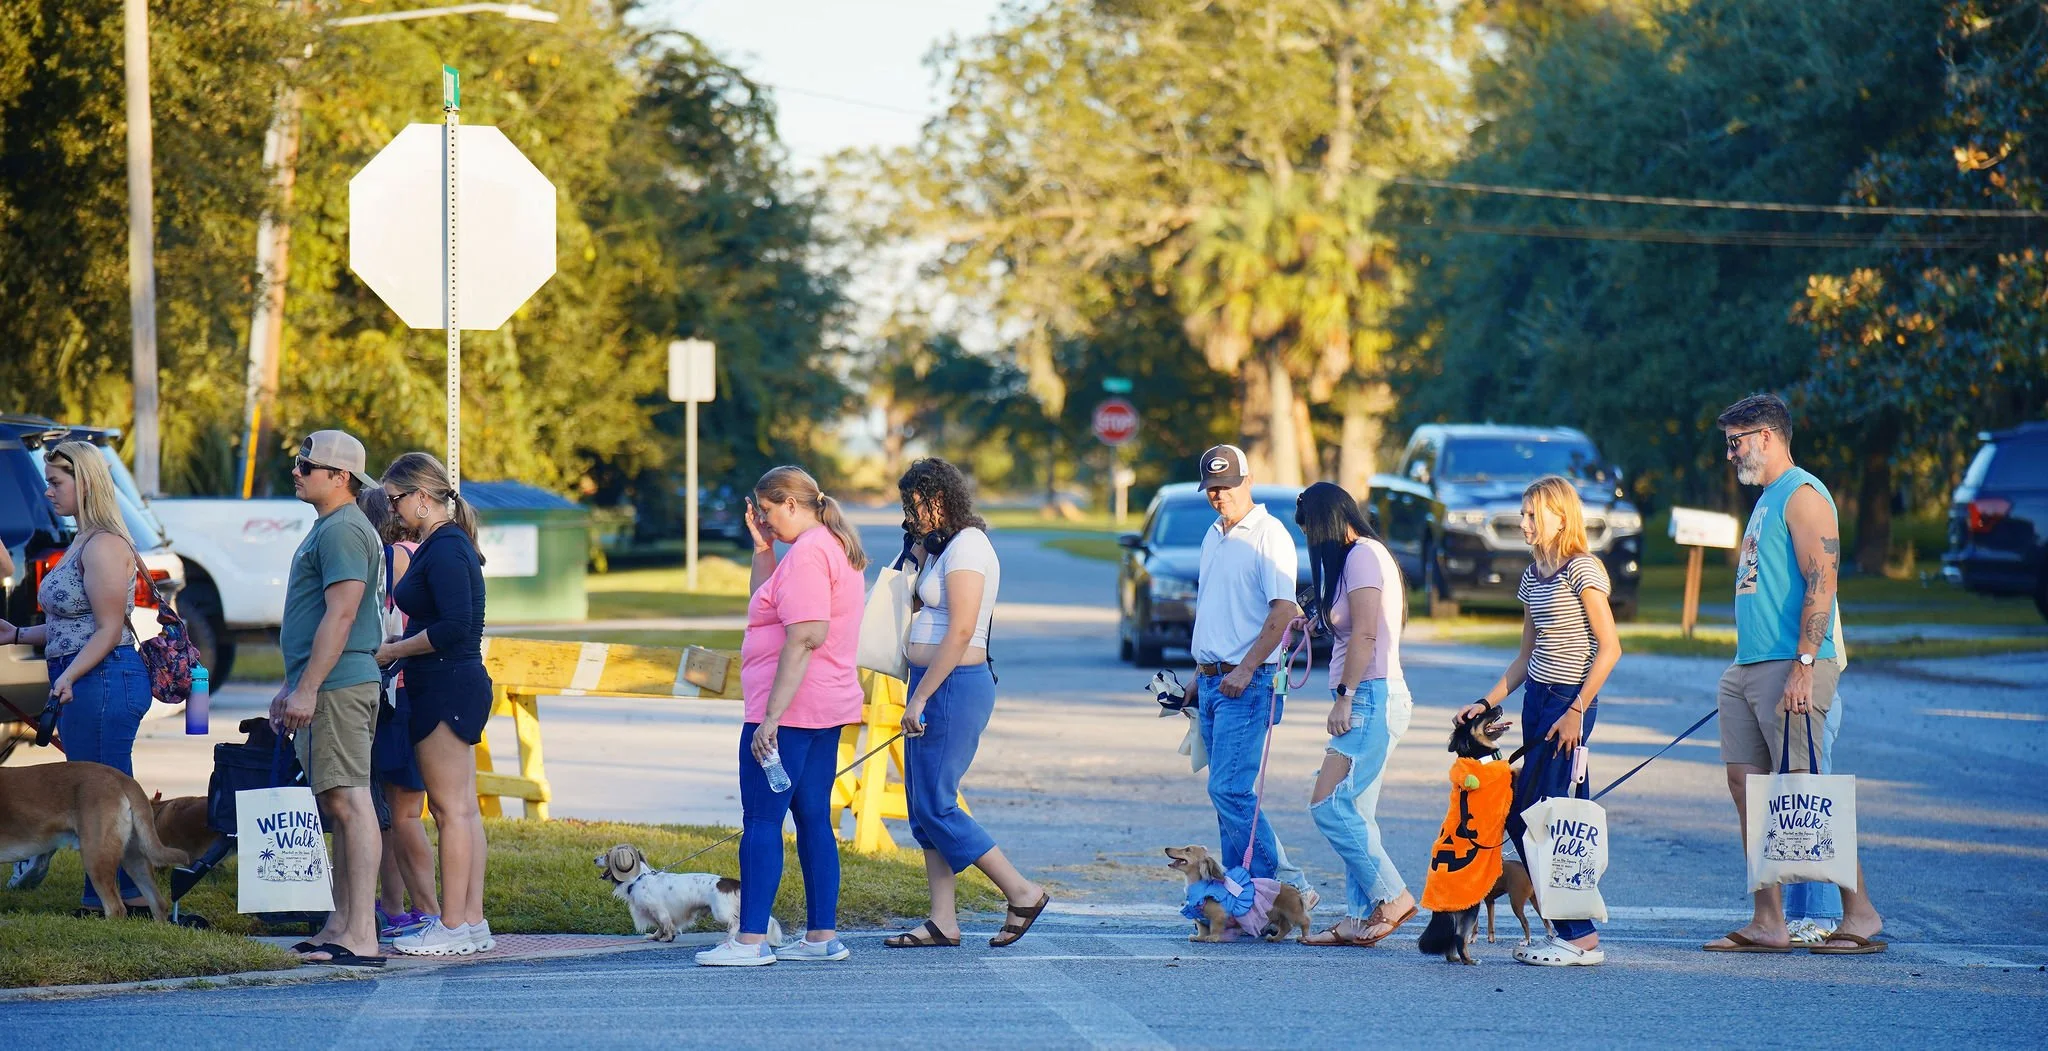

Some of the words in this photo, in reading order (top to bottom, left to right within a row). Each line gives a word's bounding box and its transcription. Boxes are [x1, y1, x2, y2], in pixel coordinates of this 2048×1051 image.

[1095, 412, 1137, 433] STOP
[242, 517, 303, 534] FX4
[1768, 793, 1833, 817] WEINER
[256, 810, 321, 836] WEINER
[1778, 809, 1824, 830] Walk
[275, 828, 317, 849] Walk
[1545, 819, 1599, 847] INER
